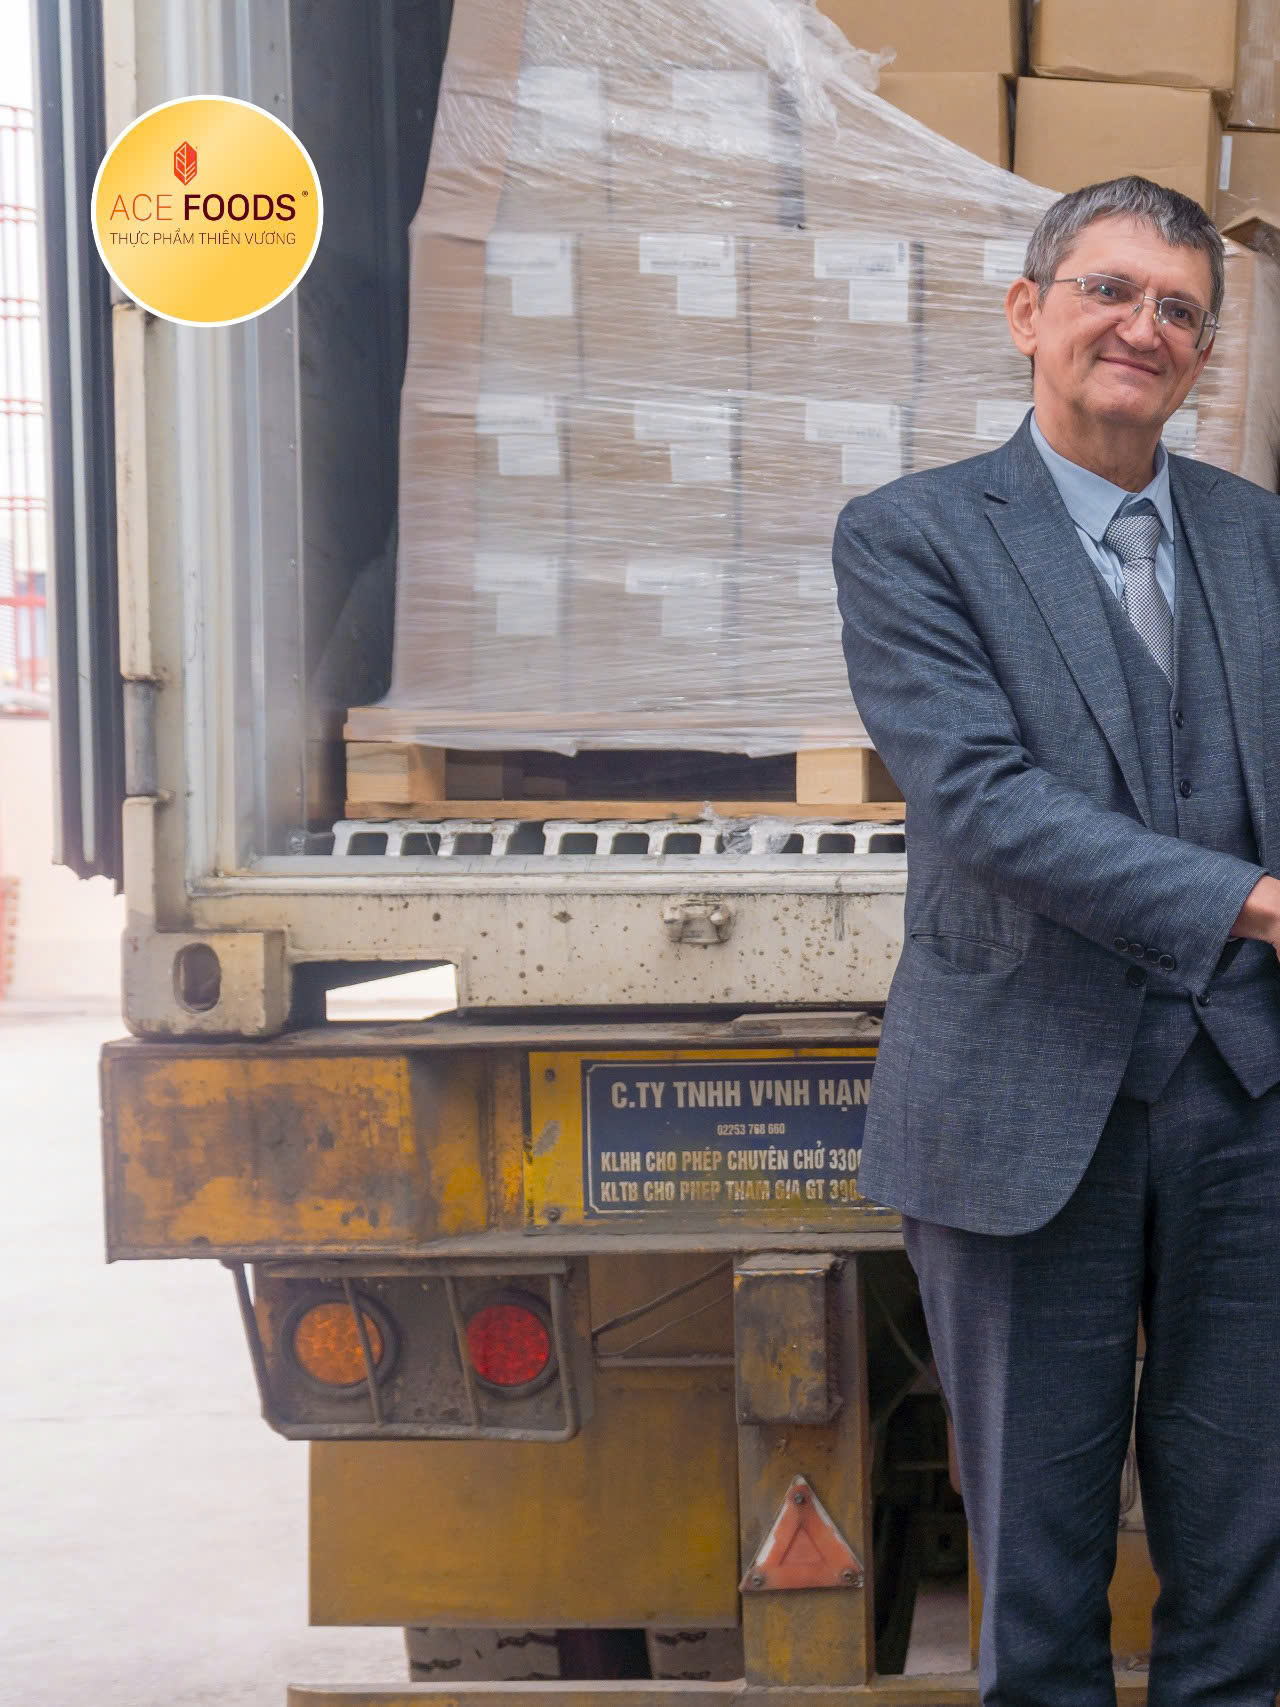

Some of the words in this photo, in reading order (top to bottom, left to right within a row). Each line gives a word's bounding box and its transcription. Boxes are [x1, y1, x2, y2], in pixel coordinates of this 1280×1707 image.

[611, 1081, 665, 1109] C.TY
[673, 1080, 741, 1108] TNHH
[717, 1123, 746, 1136] 02253
[768, 1123, 786, 1135] 660
[600, 1151, 642, 1172] KLHH
[646, 1150, 678, 1172] CHO
[681, 1146, 723, 1171] PHÉP
[727, 1145, 789, 1171] CHUYÊN
[792, 1140, 827, 1171] CHỞ
[600, 1181, 638, 1203] KLTB
[643, 1180, 675, 1201] CHO
[725, 1179, 770, 1201] THAM
[774, 1179, 800, 1200] GIA
[805, 1179, 826, 1200] GT
